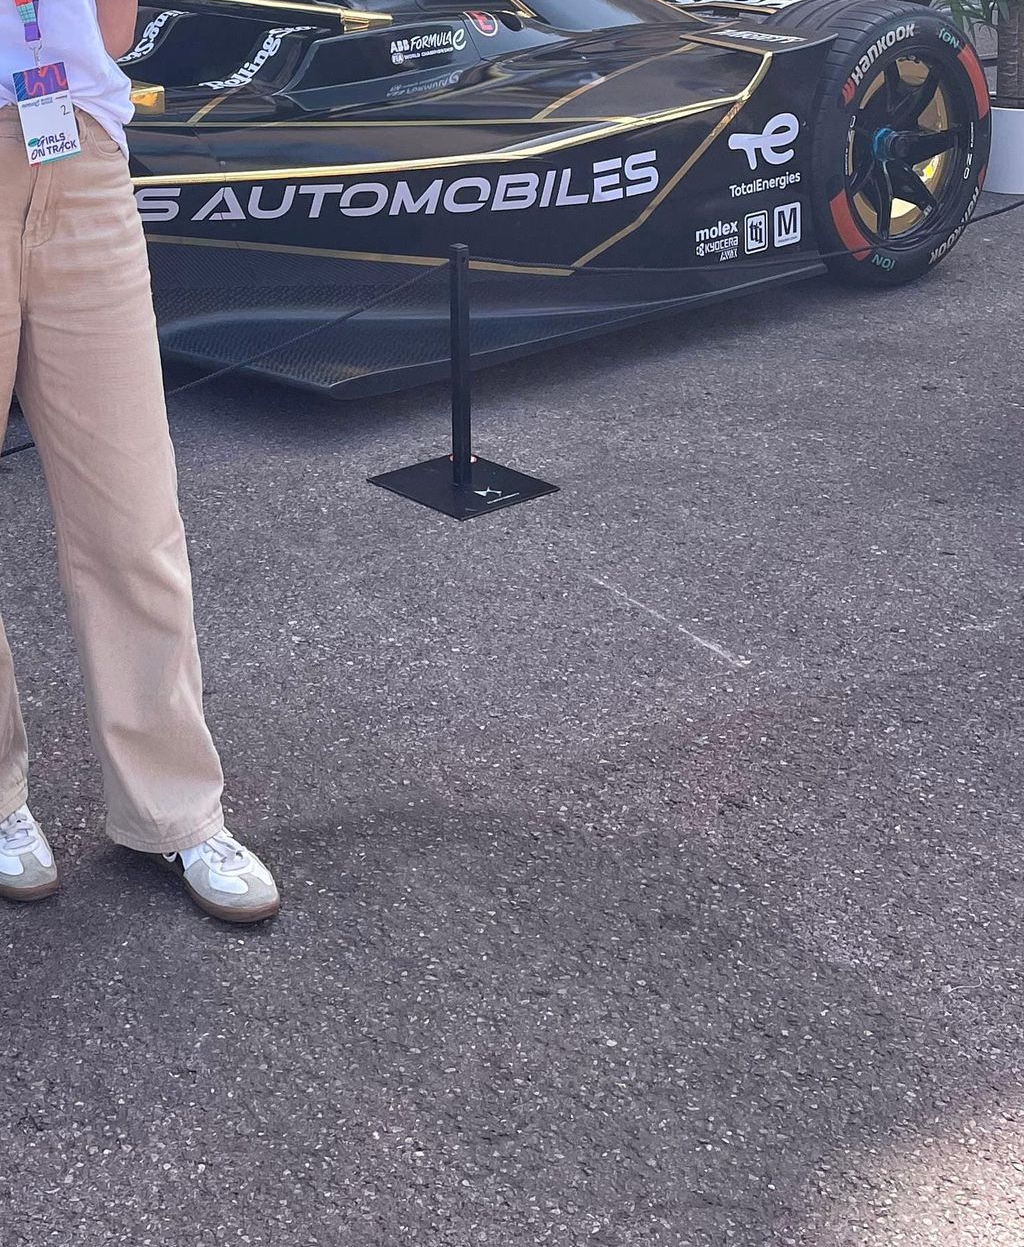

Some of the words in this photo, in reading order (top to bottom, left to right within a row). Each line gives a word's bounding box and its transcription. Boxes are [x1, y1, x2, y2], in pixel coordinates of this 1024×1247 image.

[390, 39, 410, 53] ABB
[60, 105, 71, 116] 2
[31, 147, 45, 160] ON
[46, 139, 77, 155] TRACK
[36, 132, 66, 148] GIRLS
[191, 149, 660, 223] AUTOMOBILES
[729, 171, 801, 198] TotalEnergies
[695, 220, 739, 242] molex
